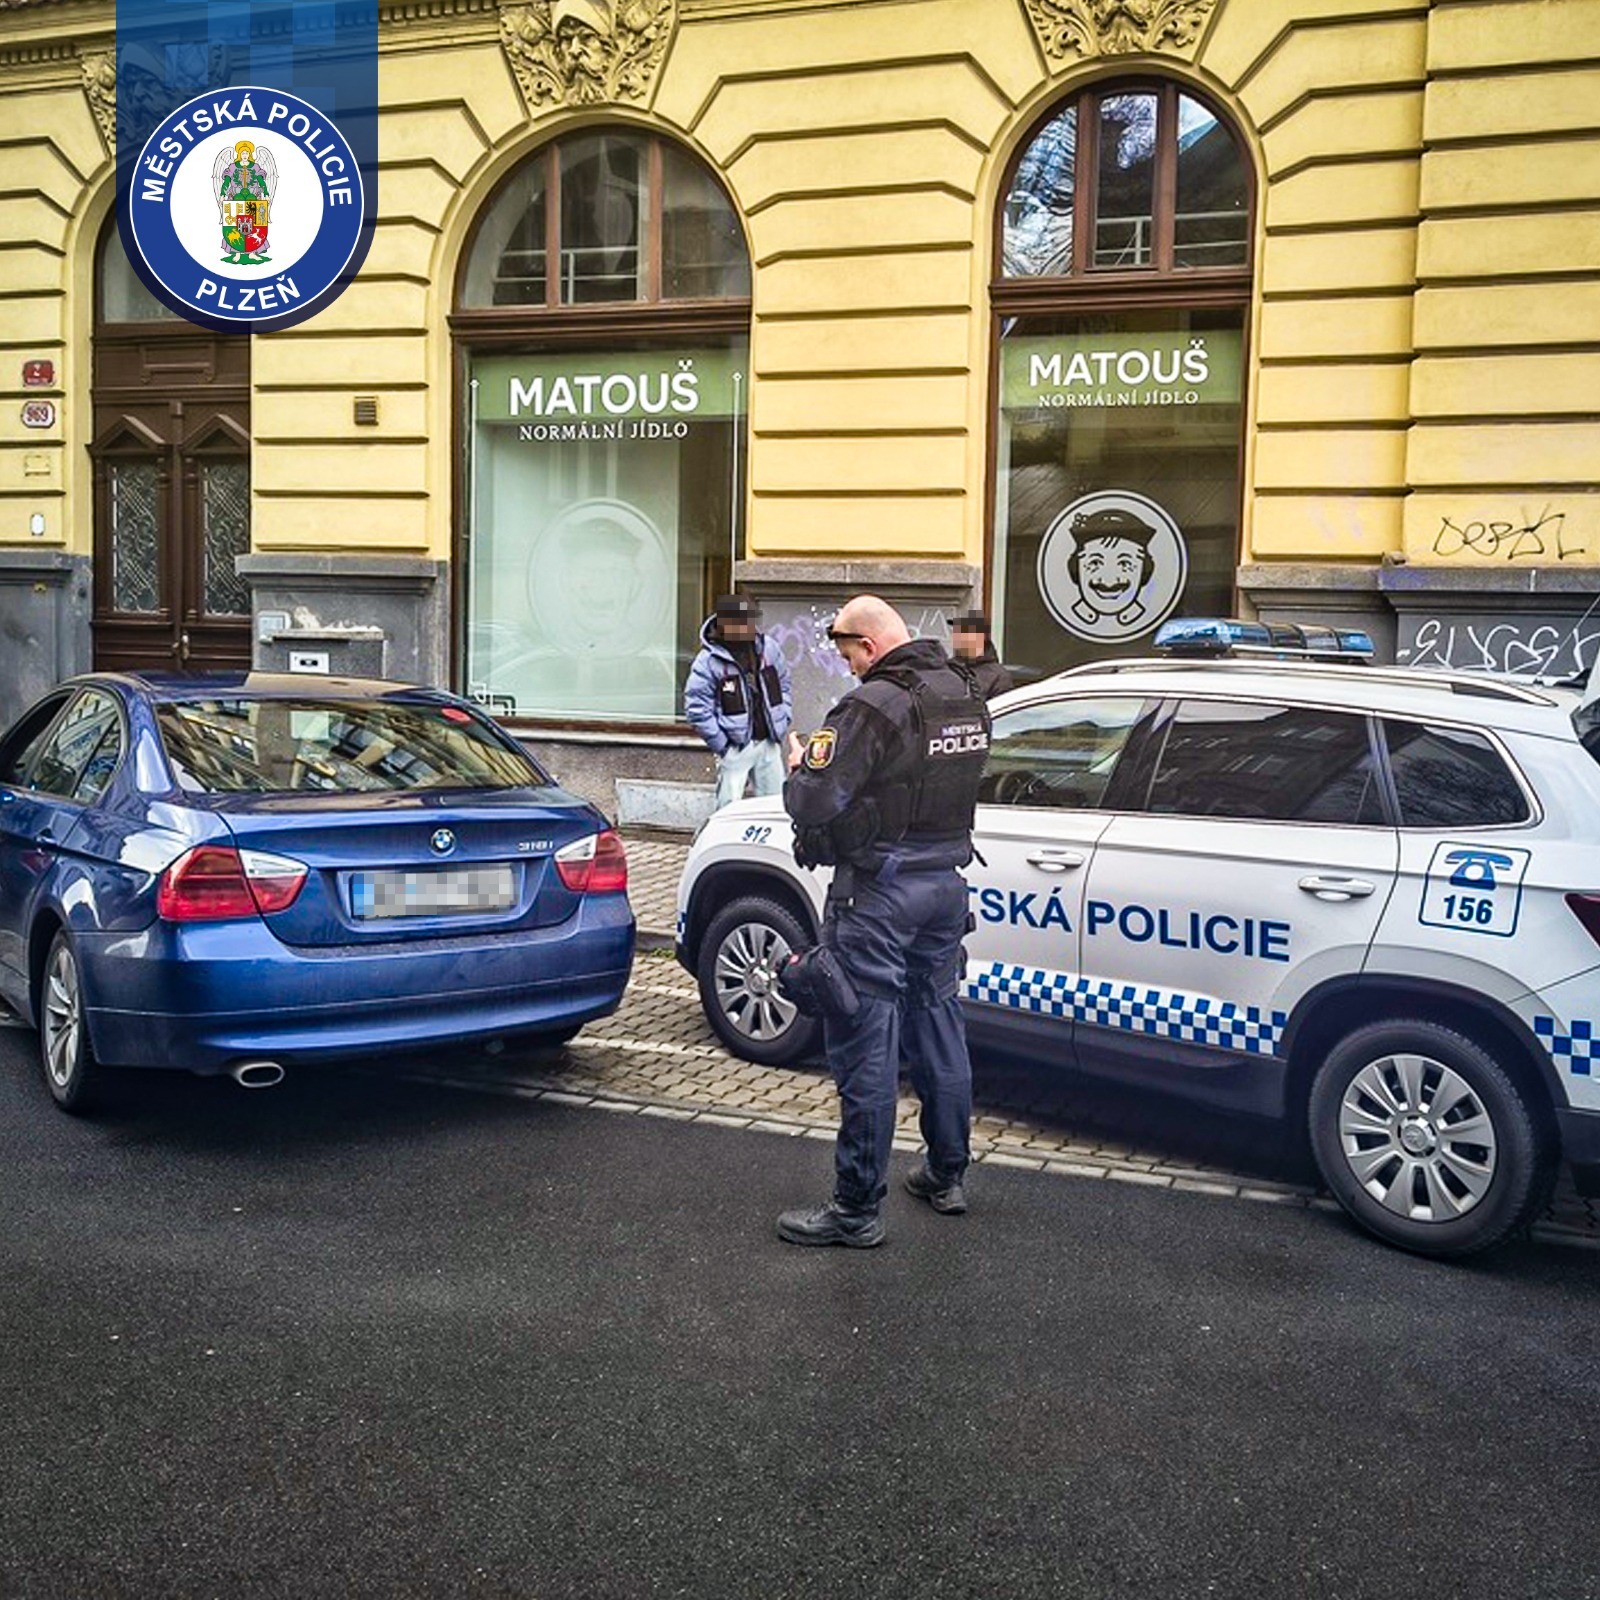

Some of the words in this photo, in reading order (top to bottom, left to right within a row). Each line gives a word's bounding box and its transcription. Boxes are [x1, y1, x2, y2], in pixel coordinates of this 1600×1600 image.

[1029, 339, 1209, 387] MATOUŠ
[509, 359, 699, 416] MATOUŠ
[1038, 389, 1137, 408] NORMÁLNÍ
[1144, 389, 1199, 407] JÍDLO
[519, 418, 624, 441] NORMÁLNÍ
[630, 419, 689, 439] JÍDLO
[928, 733, 989, 755] POLICIE
[742, 825, 772, 844] 912
[1443, 894, 1494, 925] 156
[1087, 899, 1291, 963] POLICIE
